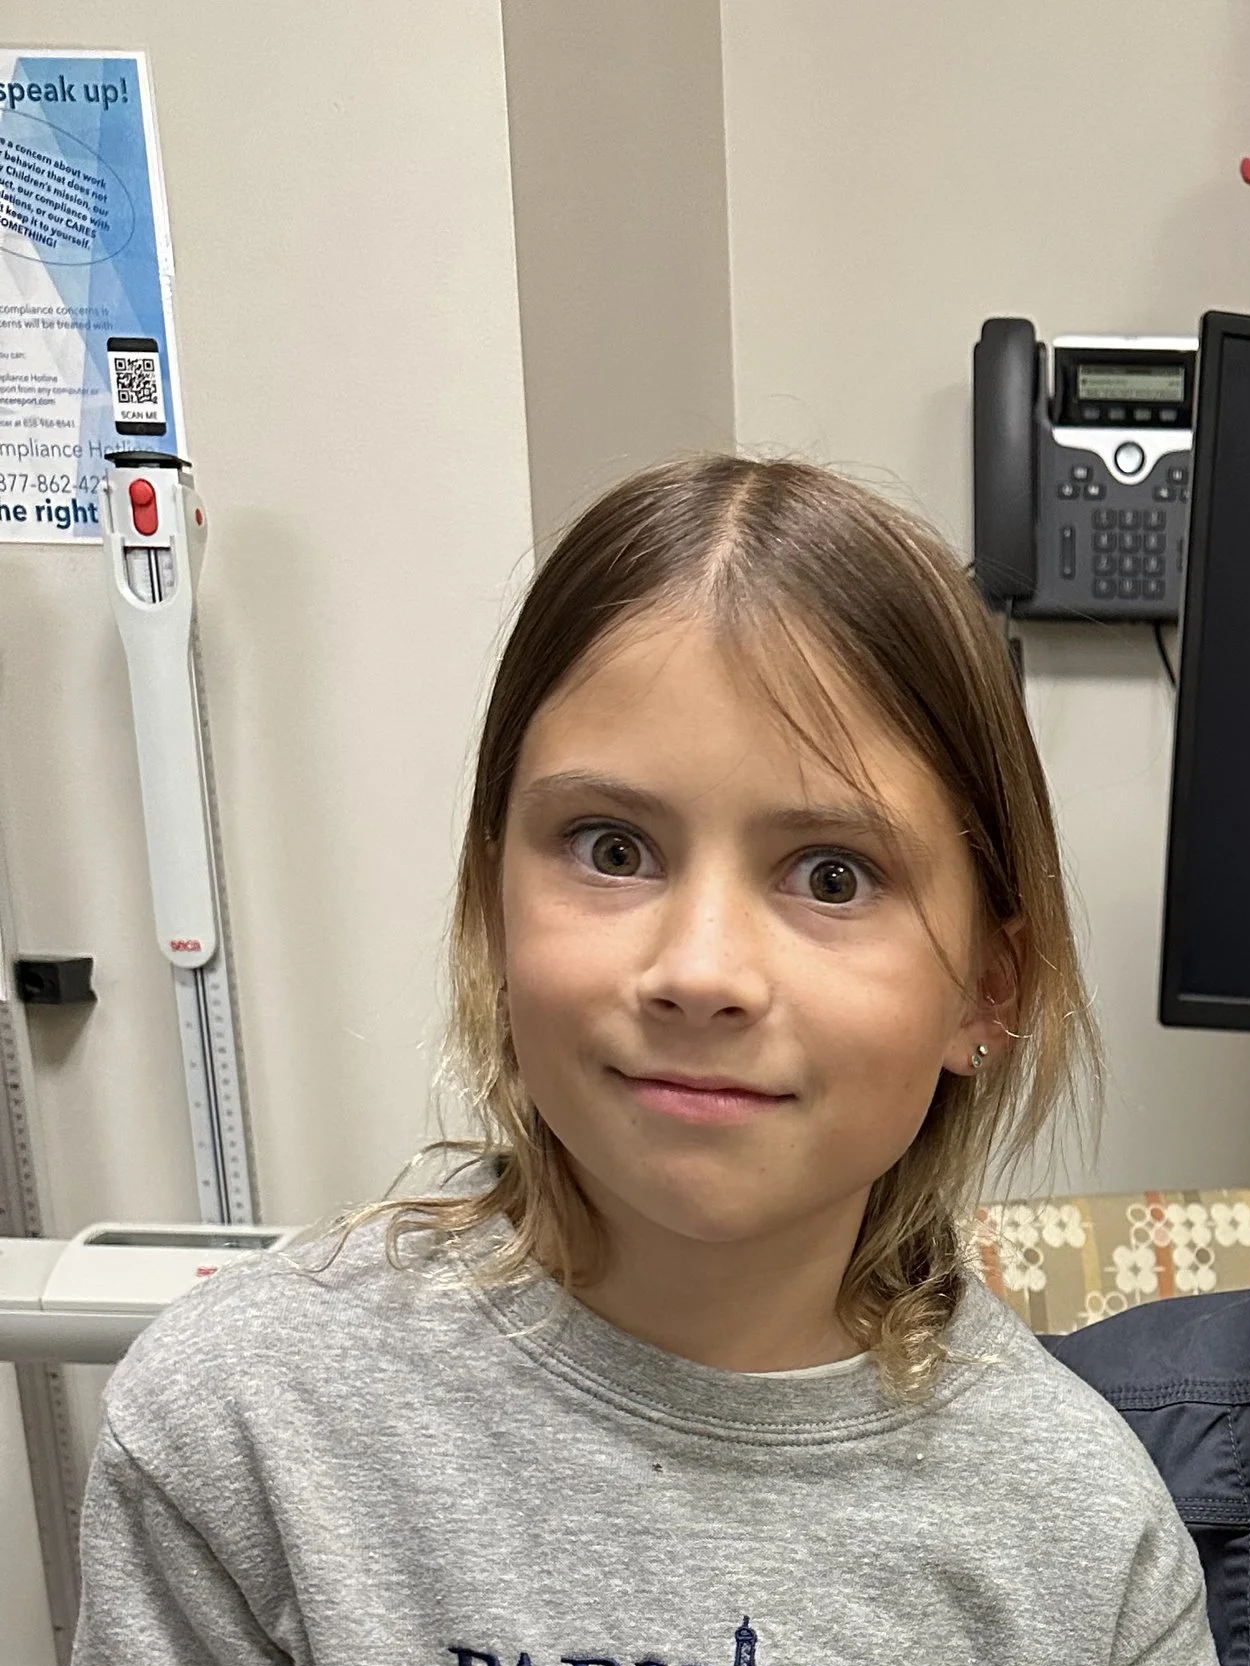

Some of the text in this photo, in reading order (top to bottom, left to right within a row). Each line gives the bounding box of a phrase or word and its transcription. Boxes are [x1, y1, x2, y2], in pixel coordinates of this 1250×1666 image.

[83, 77, 129, 111] up!
[4, 152, 107, 203] behavior that does not
[16, 144, 52, 165] concern
[54, 160, 81, 178] about
[83, 173, 107, 189] work
[6, 165, 109, 216] Children's mission, our
[17, 186, 34, 198] our
[35, 193, 88, 222] compliance
[90, 217, 110, 232] with
[36, 207, 46, 217] or
[48, 213, 64, 224] our
[65, 219, 97, 239] CARES
[0, 217, 57, 249] OMETHING!
[6, 205, 90, 251] keep it to yourself.
[24, 318, 40, 329] will
[41, 319, 55, 329] be
[57, 320, 91, 330] treated
[92, 321, 113, 331] with
[56, 306, 100, 316] concerns
[121, 411, 158, 421] SCAN ME
[35, 498, 99, 530] right
